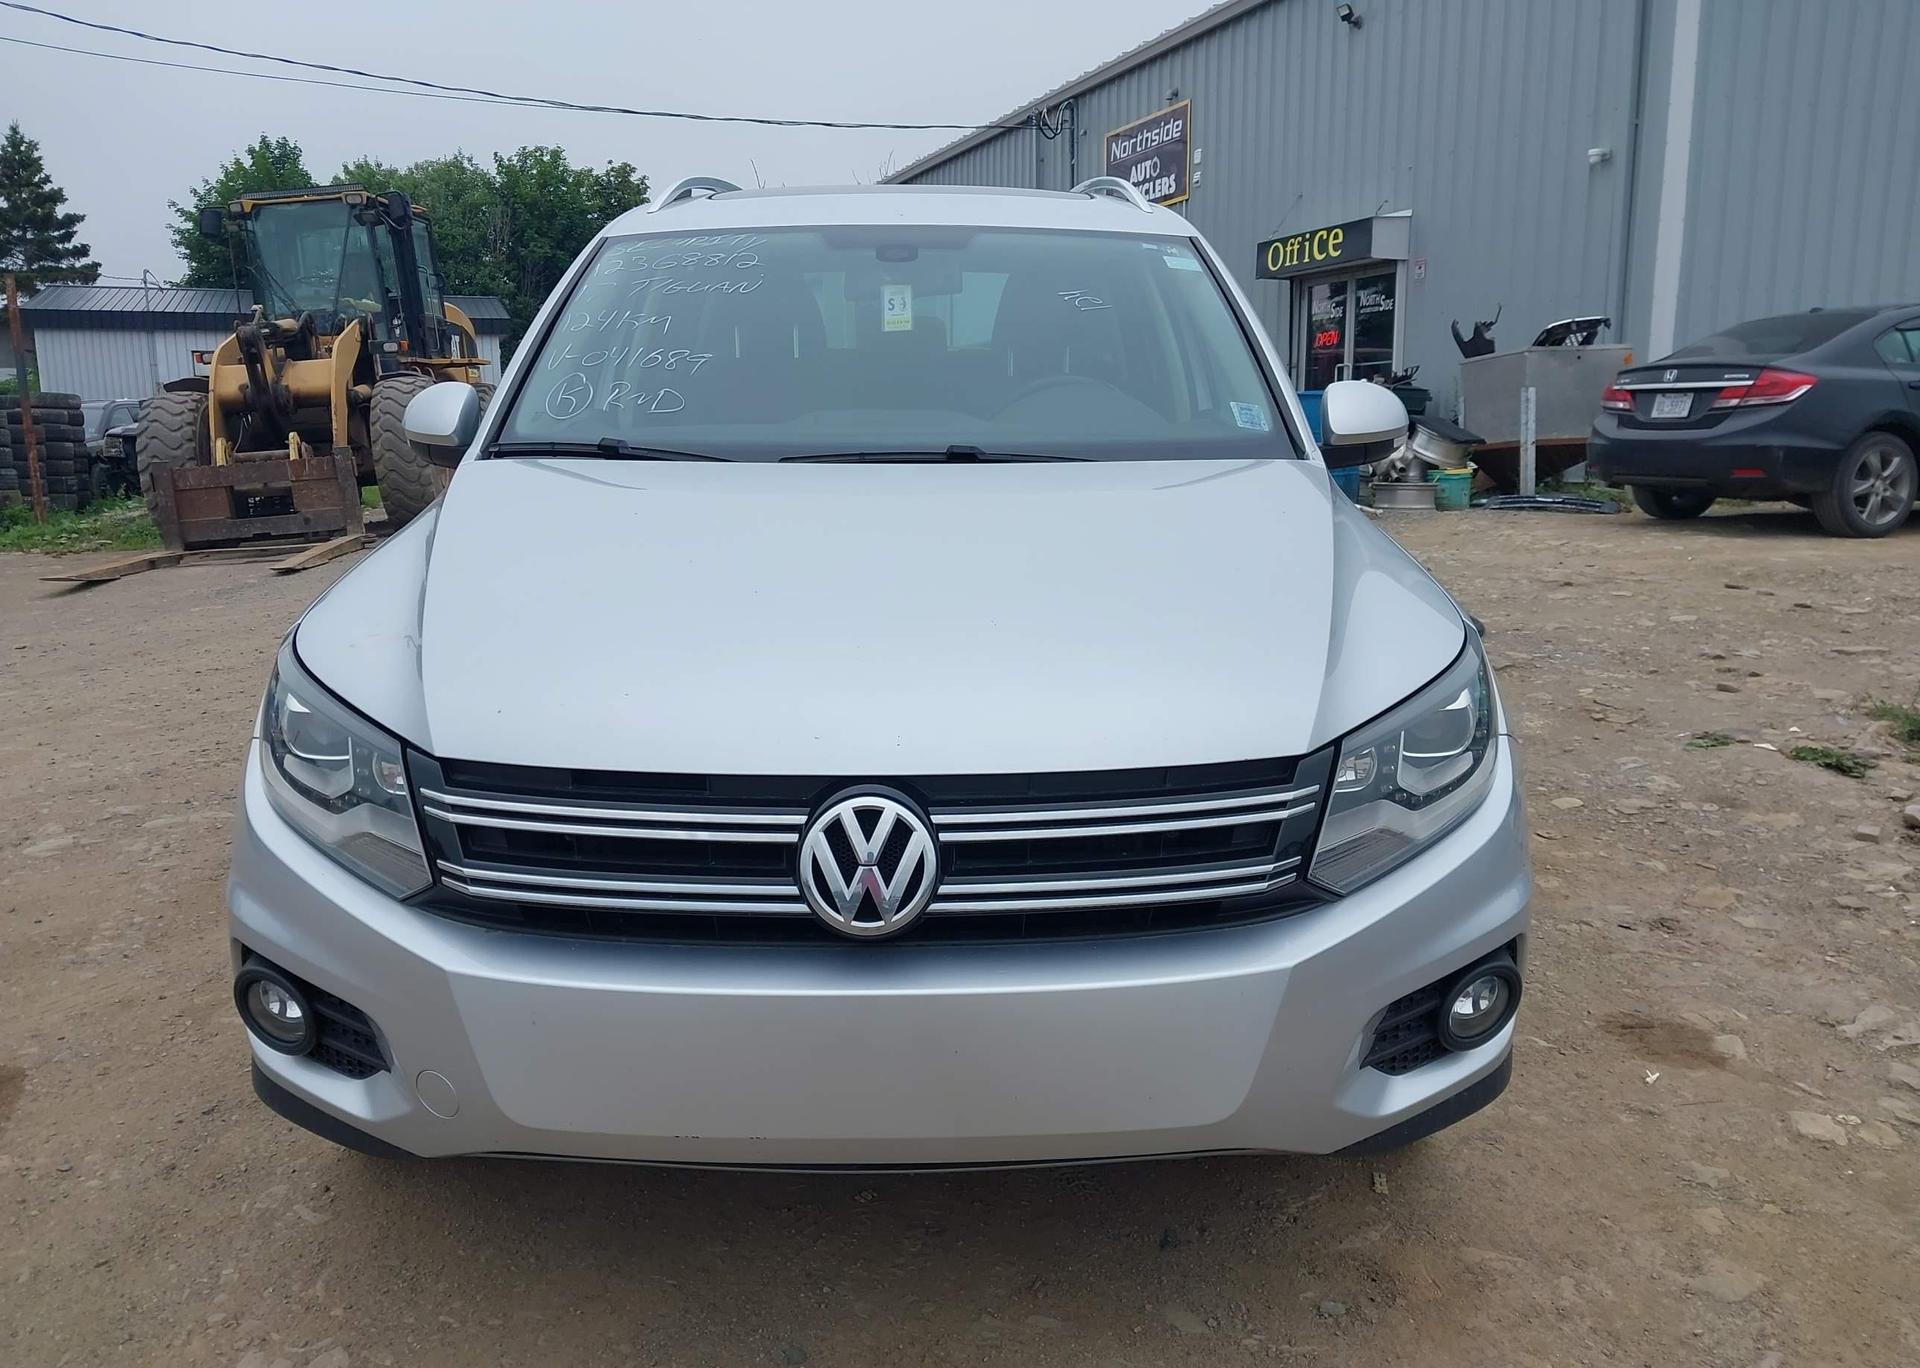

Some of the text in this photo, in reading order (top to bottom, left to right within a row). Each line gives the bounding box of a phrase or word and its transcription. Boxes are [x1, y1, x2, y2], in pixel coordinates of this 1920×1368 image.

[1111, 118, 1182, 161] Northside
[1130, 156, 1160, 183] AUTO
[1267, 227, 1344, 271] Office
[1315, 329, 1340, 346] OPEN
